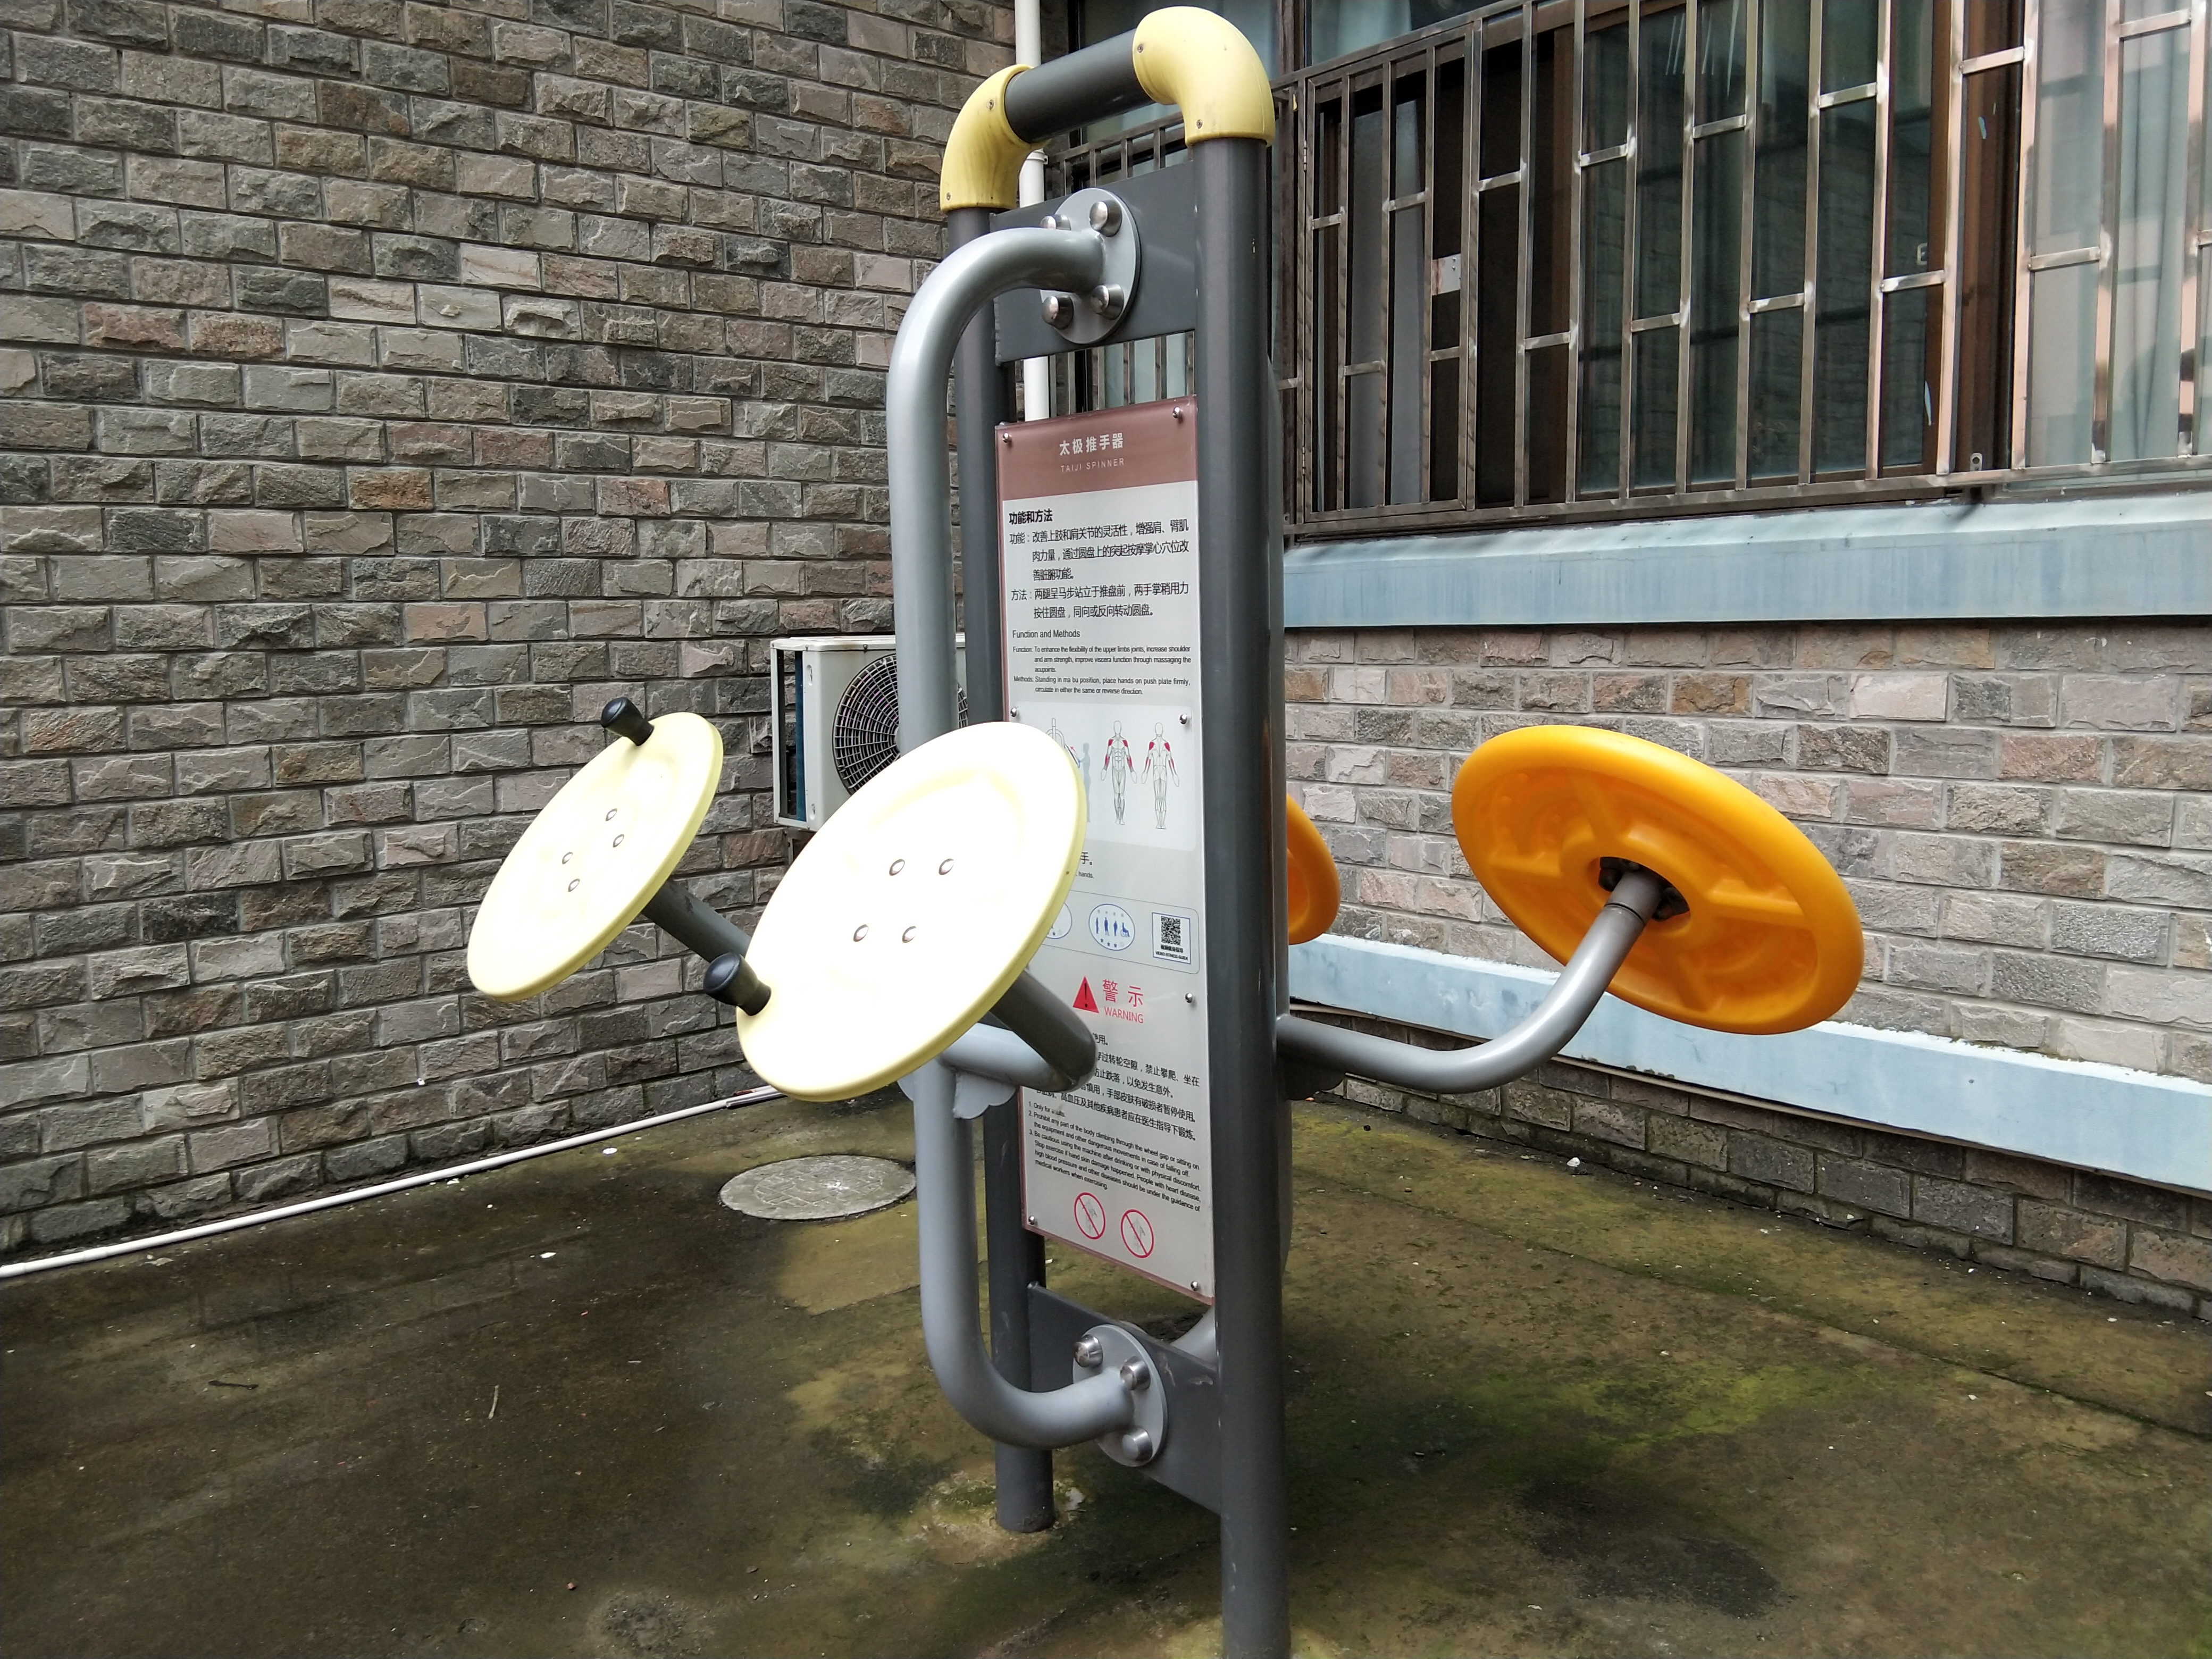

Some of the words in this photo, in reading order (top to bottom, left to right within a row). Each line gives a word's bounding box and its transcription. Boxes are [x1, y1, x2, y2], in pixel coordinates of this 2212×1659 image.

[1059, 432, 1124, 456] 太极推手器
[1086, 458, 1125, 470] SPINNER
[1009, 508, 1053, 524] 功能和方法
[1032, 539, 1189, 562] 肉力量，通过圆盘上的突起按摩掌心穴位改
[1034, 603, 1153, 619] 按住圆盘，同向或反向转动圆盘。
[1053, 629, 1080, 638] Methods
[1103, 979, 1143, 1007] 警示
[1104, 1007, 1144, 1024] WARNING
[1034, 1103, 1043, 1111] Only
[1034, 1112, 1050, 1122] Prohibit
[1084, 1127, 1095, 1137] body
[1096, 1132, 1115, 1144] climbing
[1116, 1138, 1134, 1149] through
[1144, 1147, 1158, 1156] wheel
[1176, 1158, 1192, 1168] sitting
[1042, 1125, 1065, 1136] equipment
[1088, 1139, 1112, 1151] dangerous
[1113, 1148, 1140, 1160] movements
[1166, 1163, 1180, 1175] falling
[1042, 1134, 1060, 1144] cautious
[1061, 1140, 1073, 1149] using
[1082, 1147, 1102, 1158] machine
[1115, 1157, 1133, 1169] drinking
[1152, 1170, 1172, 1181] physical
[1173, 1177, 1201, 1192] discomfort.
